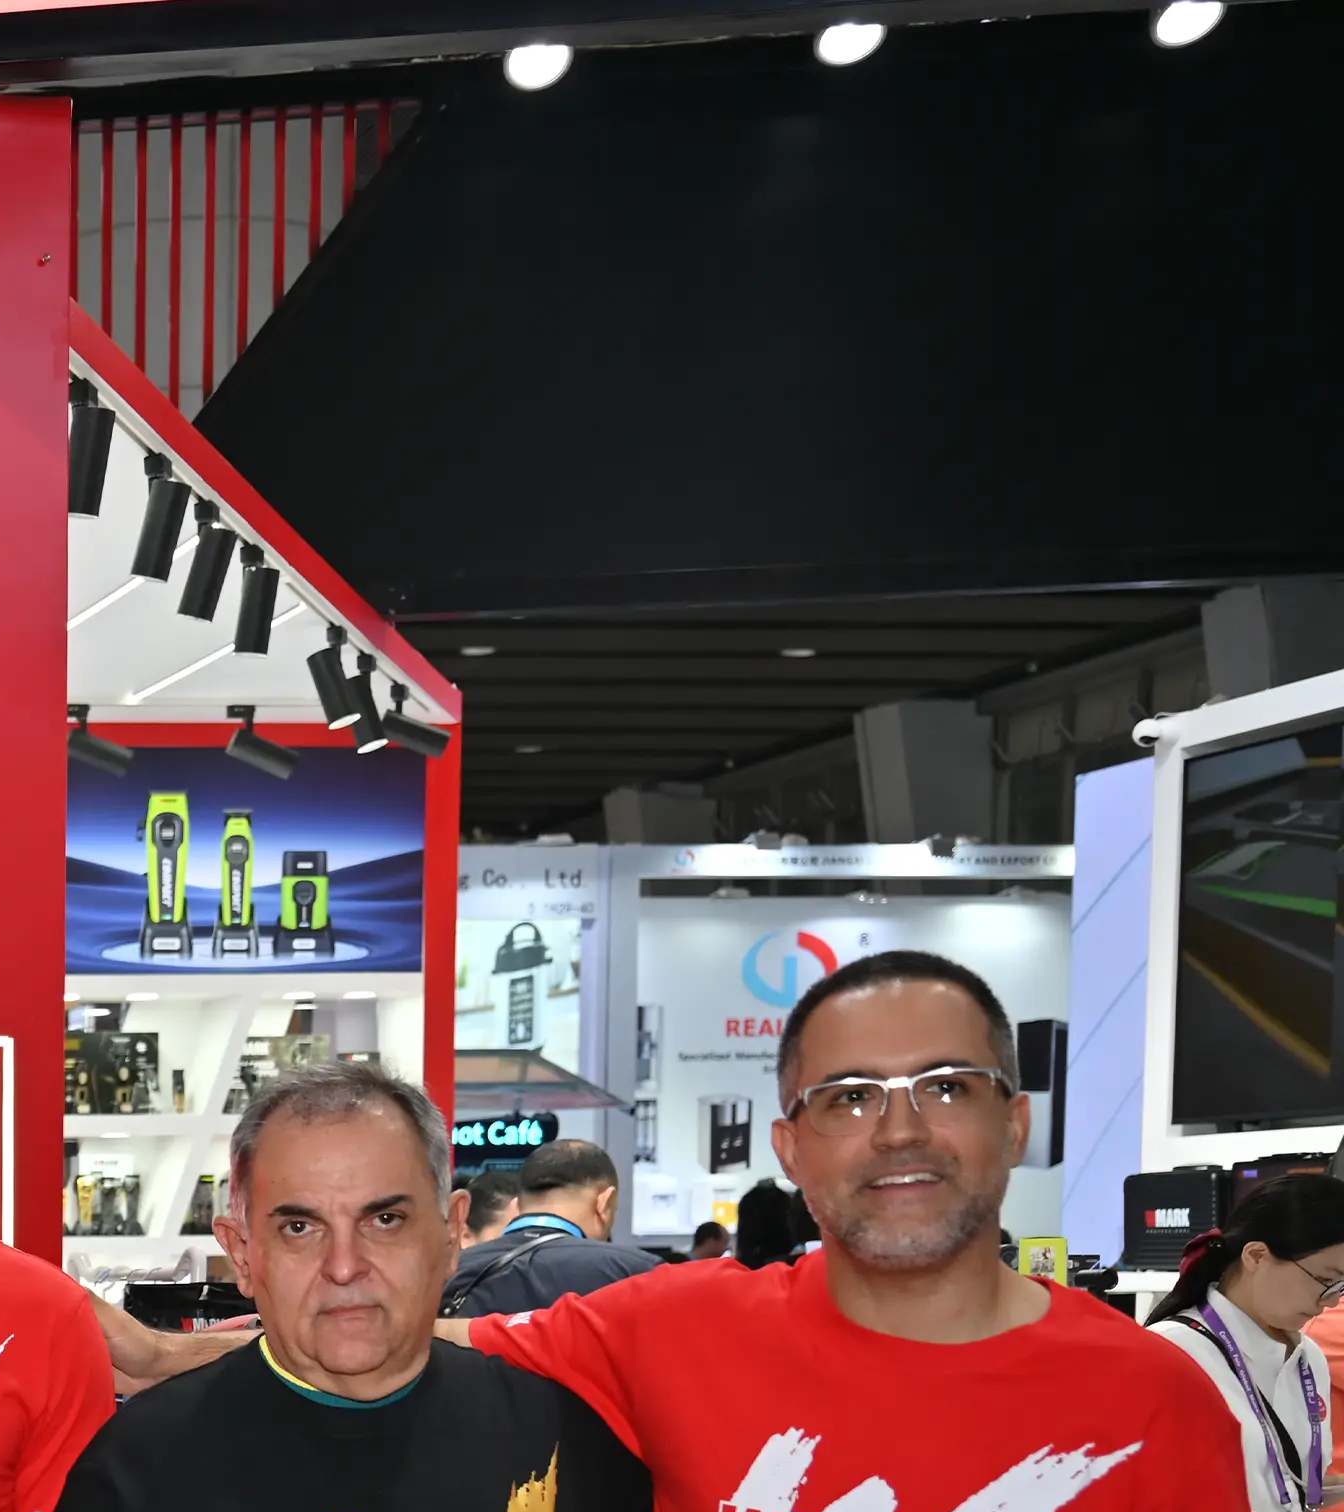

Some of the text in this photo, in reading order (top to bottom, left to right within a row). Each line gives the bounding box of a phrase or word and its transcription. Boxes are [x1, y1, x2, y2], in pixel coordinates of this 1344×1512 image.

[487, 1119, 544, 1146] Café
[1219, 1330, 1234, 1352] Canton
[1239, 1369, 1251, 1392] Global
